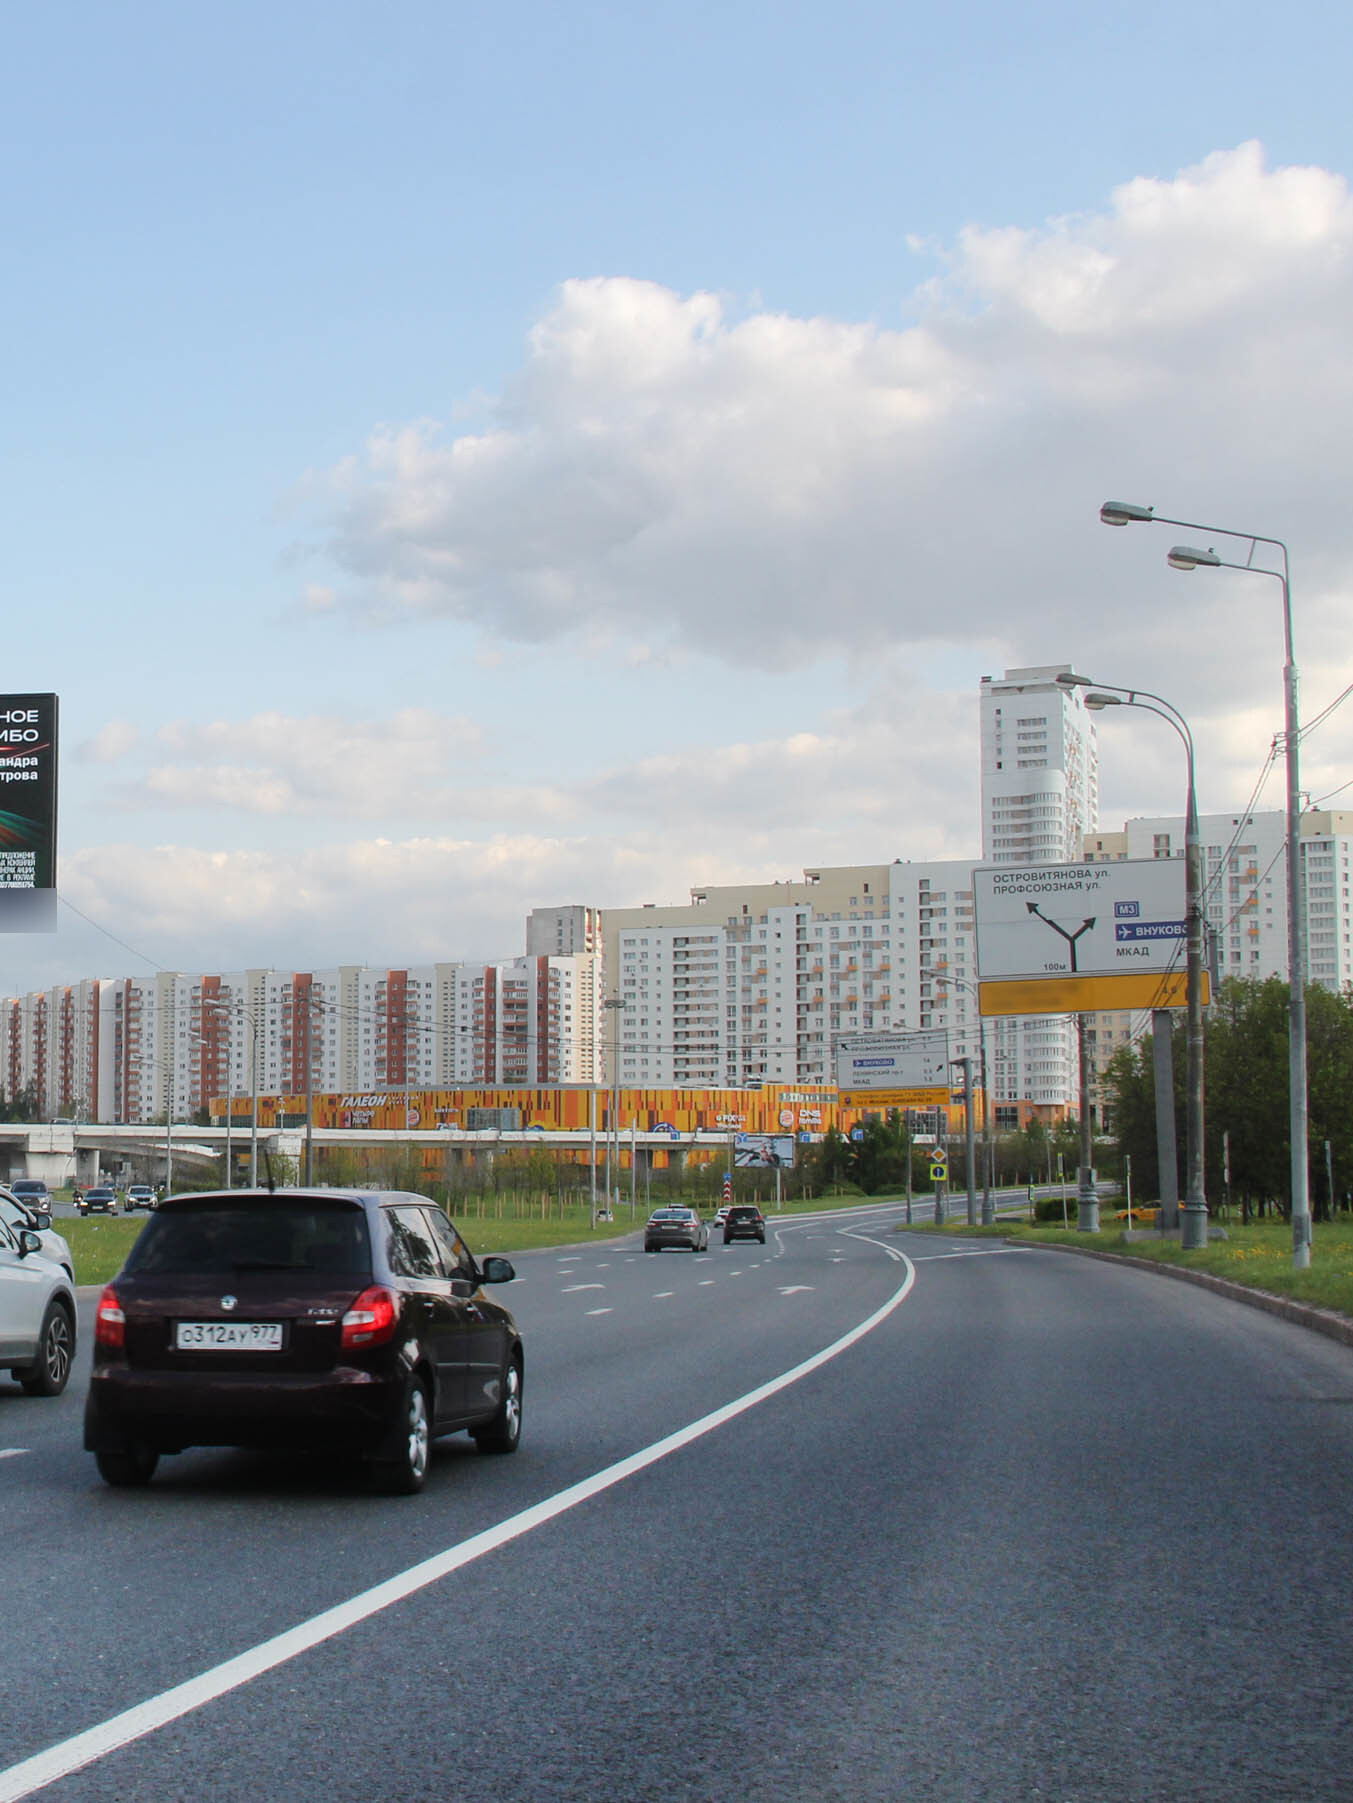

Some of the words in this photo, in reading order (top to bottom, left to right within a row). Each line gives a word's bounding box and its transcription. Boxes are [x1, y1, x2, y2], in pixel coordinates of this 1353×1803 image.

[993, 870, 1092, 883] ОСТРОВИТЯНОВА
[1094, 870, 1110, 880] ул.
[993, 882, 1082, 894] ПРОФСОЮЗНАЯ
[1086, 882, 1102, 891] ул.
[1116, 946, 1149, 957] МКАД
[1044, 963, 1066, 971] 100м
[340, 1095, 387, 1107] ГАЛЕОН
